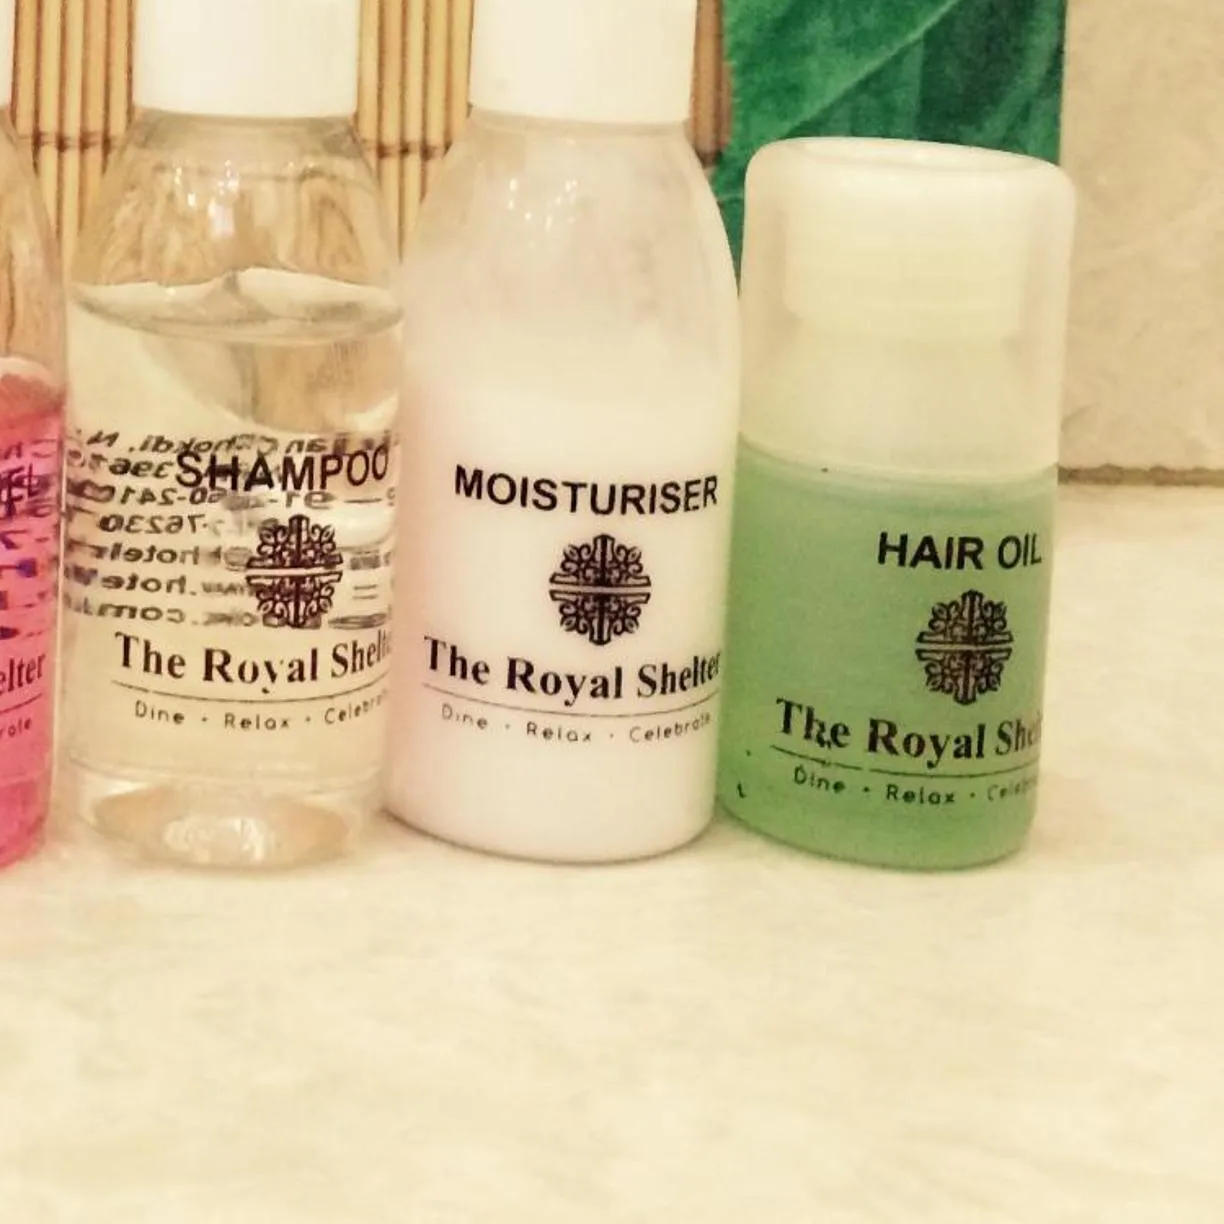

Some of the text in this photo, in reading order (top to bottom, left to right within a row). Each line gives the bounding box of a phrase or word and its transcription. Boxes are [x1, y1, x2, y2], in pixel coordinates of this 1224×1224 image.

[175, 440, 390, 493] SHAMPOO
[454, 463, 718, 516] MOISTURISER
[877, 531, 1043, 571] HAIR OIL
[114, 630, 186, 679] The
[202, 647, 318, 695] Royal
[424, 635, 721, 707] The Royal Shelter
[134, 699, 186, 725] Dine
[223, 712, 290, 731] Relax
[441, 702, 489, 730] Dine
[526, 721, 592, 743] Relax
[775, 697, 852, 750] The
[864, 717, 986, 769] Royal
[793, 764, 846, 793] Dine
[885, 783, 956, 806] Relax
